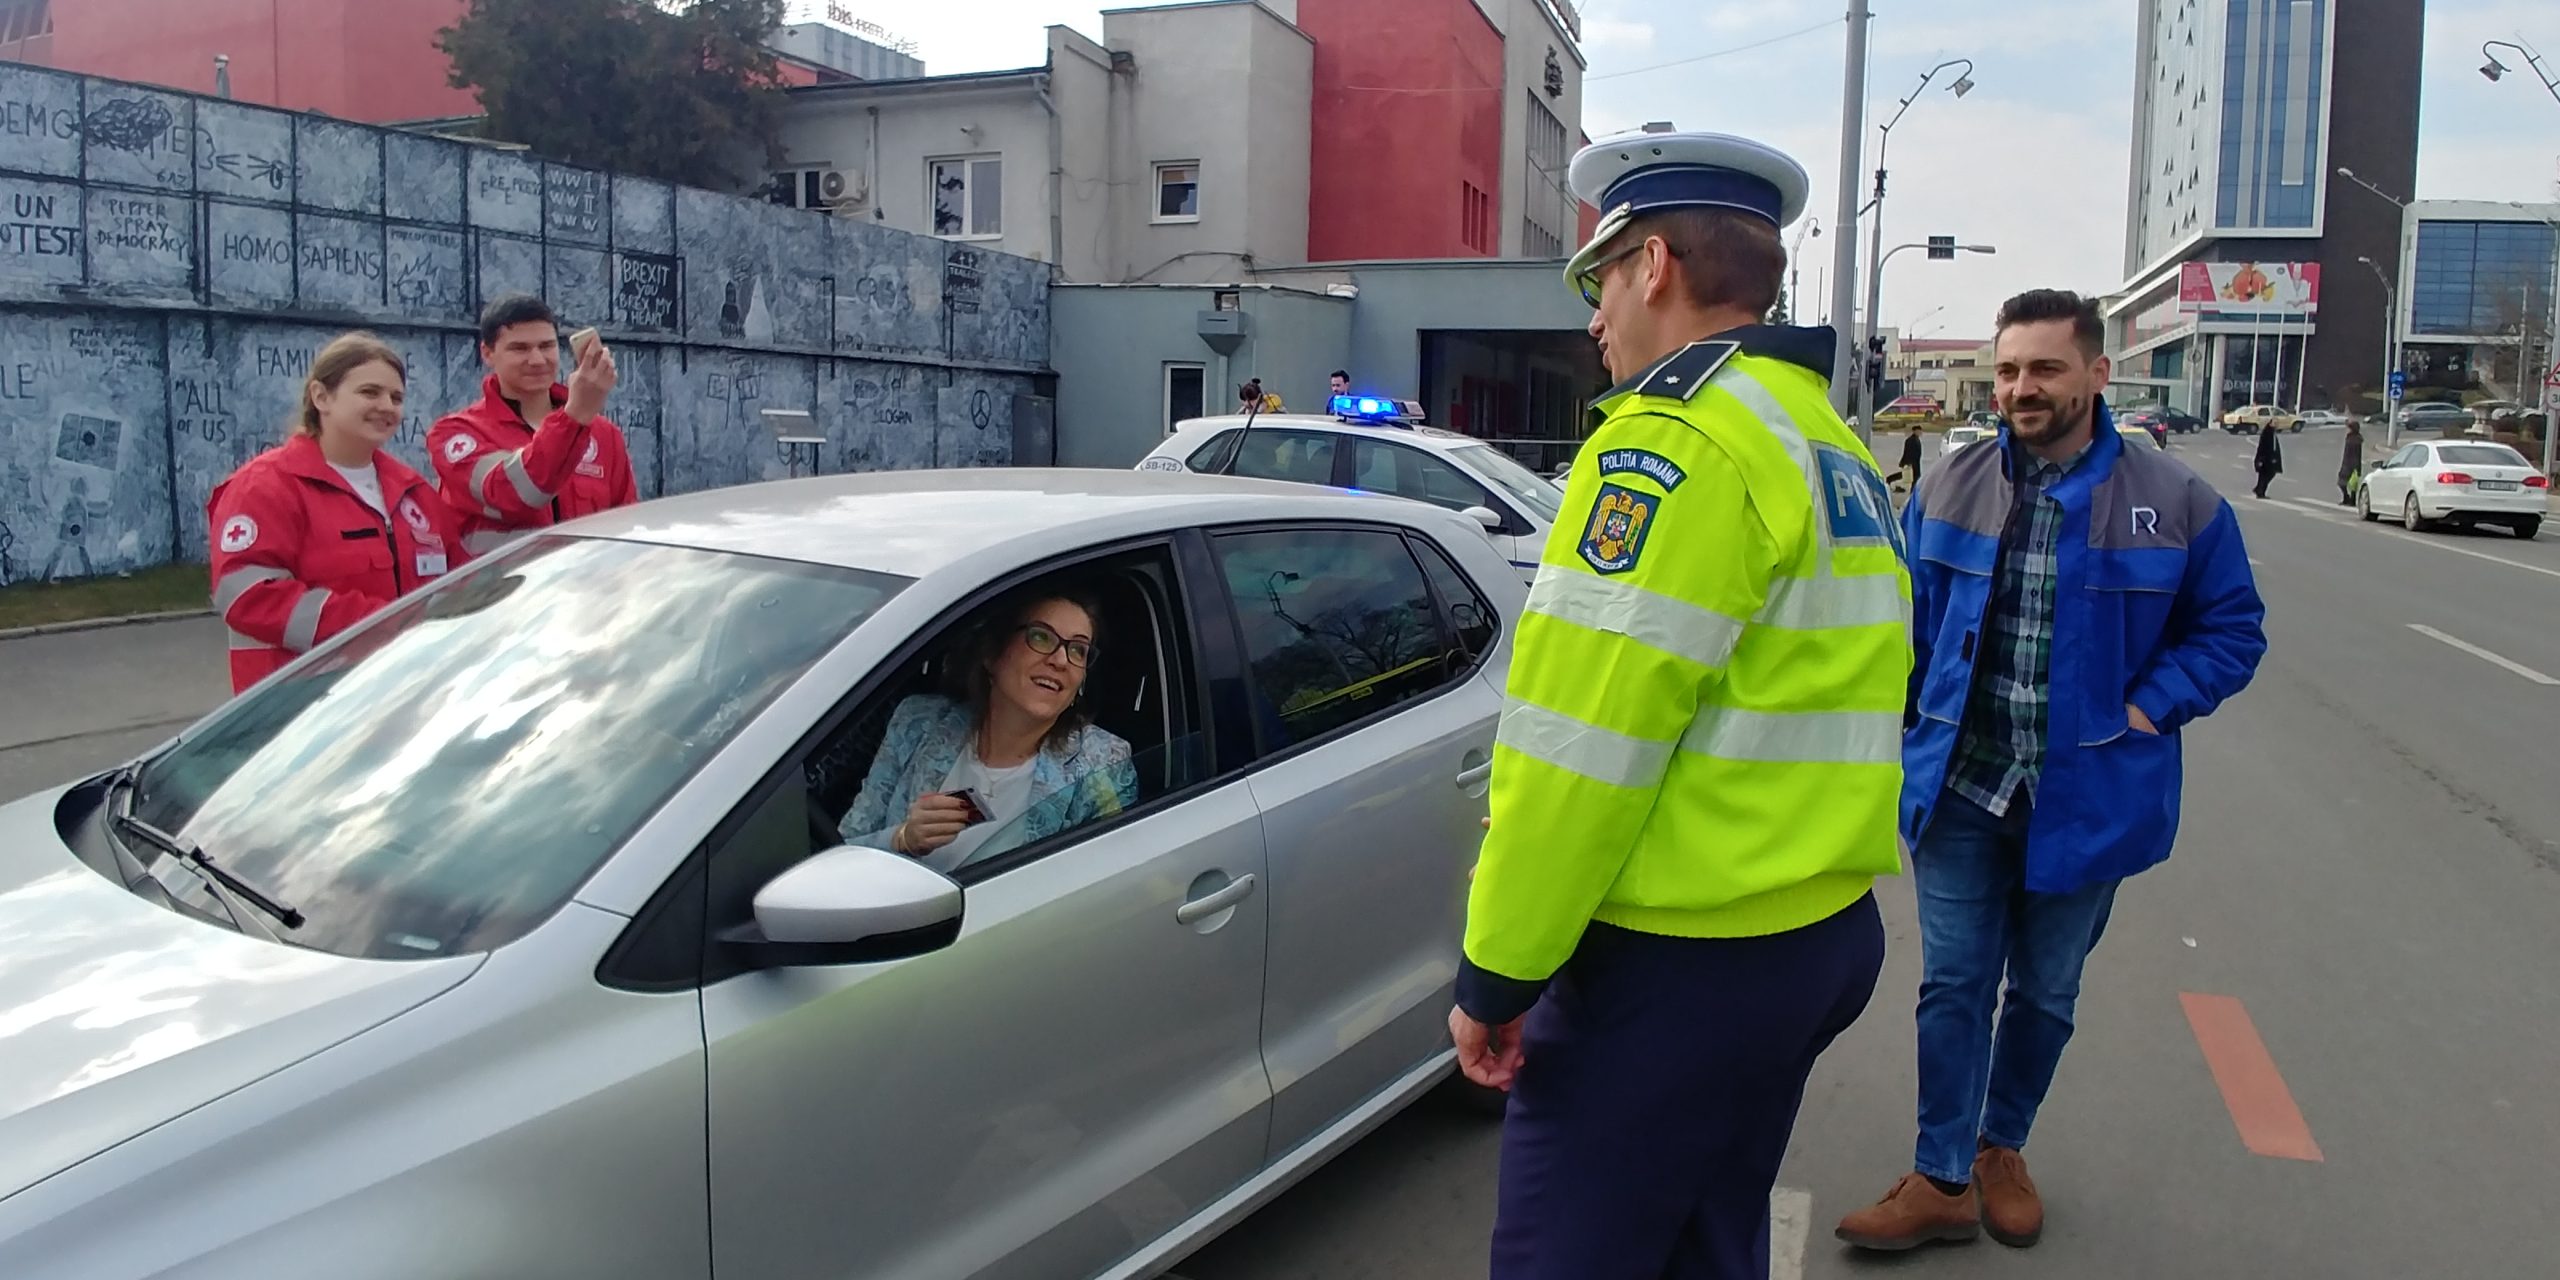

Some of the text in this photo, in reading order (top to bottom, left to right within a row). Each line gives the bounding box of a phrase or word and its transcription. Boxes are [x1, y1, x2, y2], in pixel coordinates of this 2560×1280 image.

[15, 193, 54, 219] UN
[110, 198, 166, 220] PEPPER
[114, 216, 169, 240] SPRAY
[97, 229, 188, 262] DEMOCRACY
[224, 233, 380, 281] HOMO SAPIENS
[623, 258, 670, 287] BREXIT
[635, 281, 659, 298] YOU
[655, 297, 673, 315] MY
[202, 418, 227, 443] US
[1640, 456, 1682, 487] ROMÂNĂ
